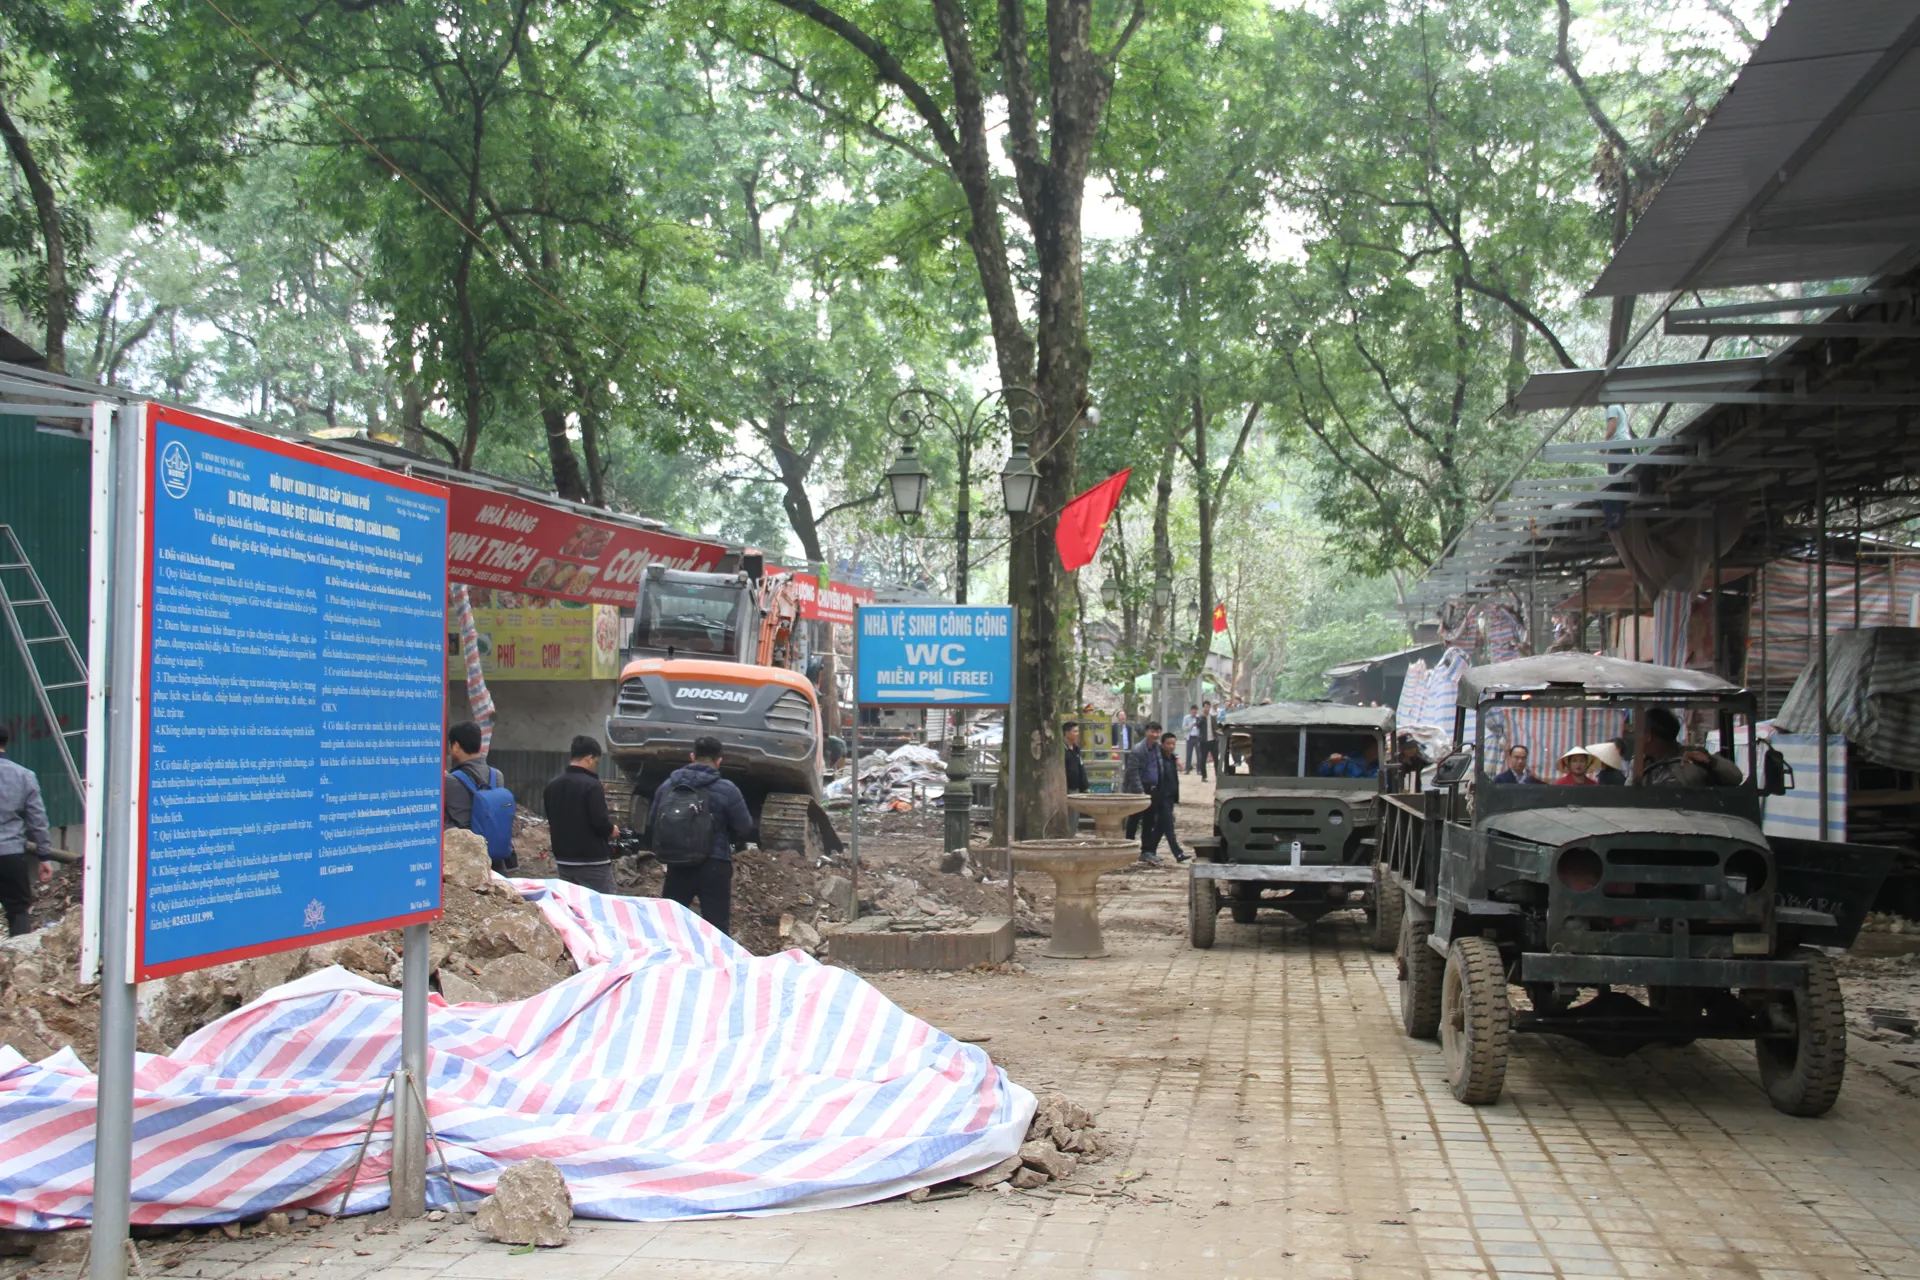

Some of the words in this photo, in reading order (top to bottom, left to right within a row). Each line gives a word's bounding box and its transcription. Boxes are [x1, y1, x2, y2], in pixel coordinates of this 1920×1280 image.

[478, 536, 540, 572] THÍCH
[864, 610, 888, 636] NHÀ
[892, 610, 905, 641] VỆ
[909, 615, 937, 636] SINH
[940, 611, 972, 636] CÔNG
[975, 611, 1007, 641] CỘNG
[498, 636, 516, 668] PHỞ
[542, 642, 562, 668] CƠM
[905, 644, 966, 666] WC
[877, 666, 914, 684] MIỄN
[919, 668, 943, 684] PHÍ
[948, 672, 993, 685] (FREE)
[676, 688, 749, 703] DOOSAN
